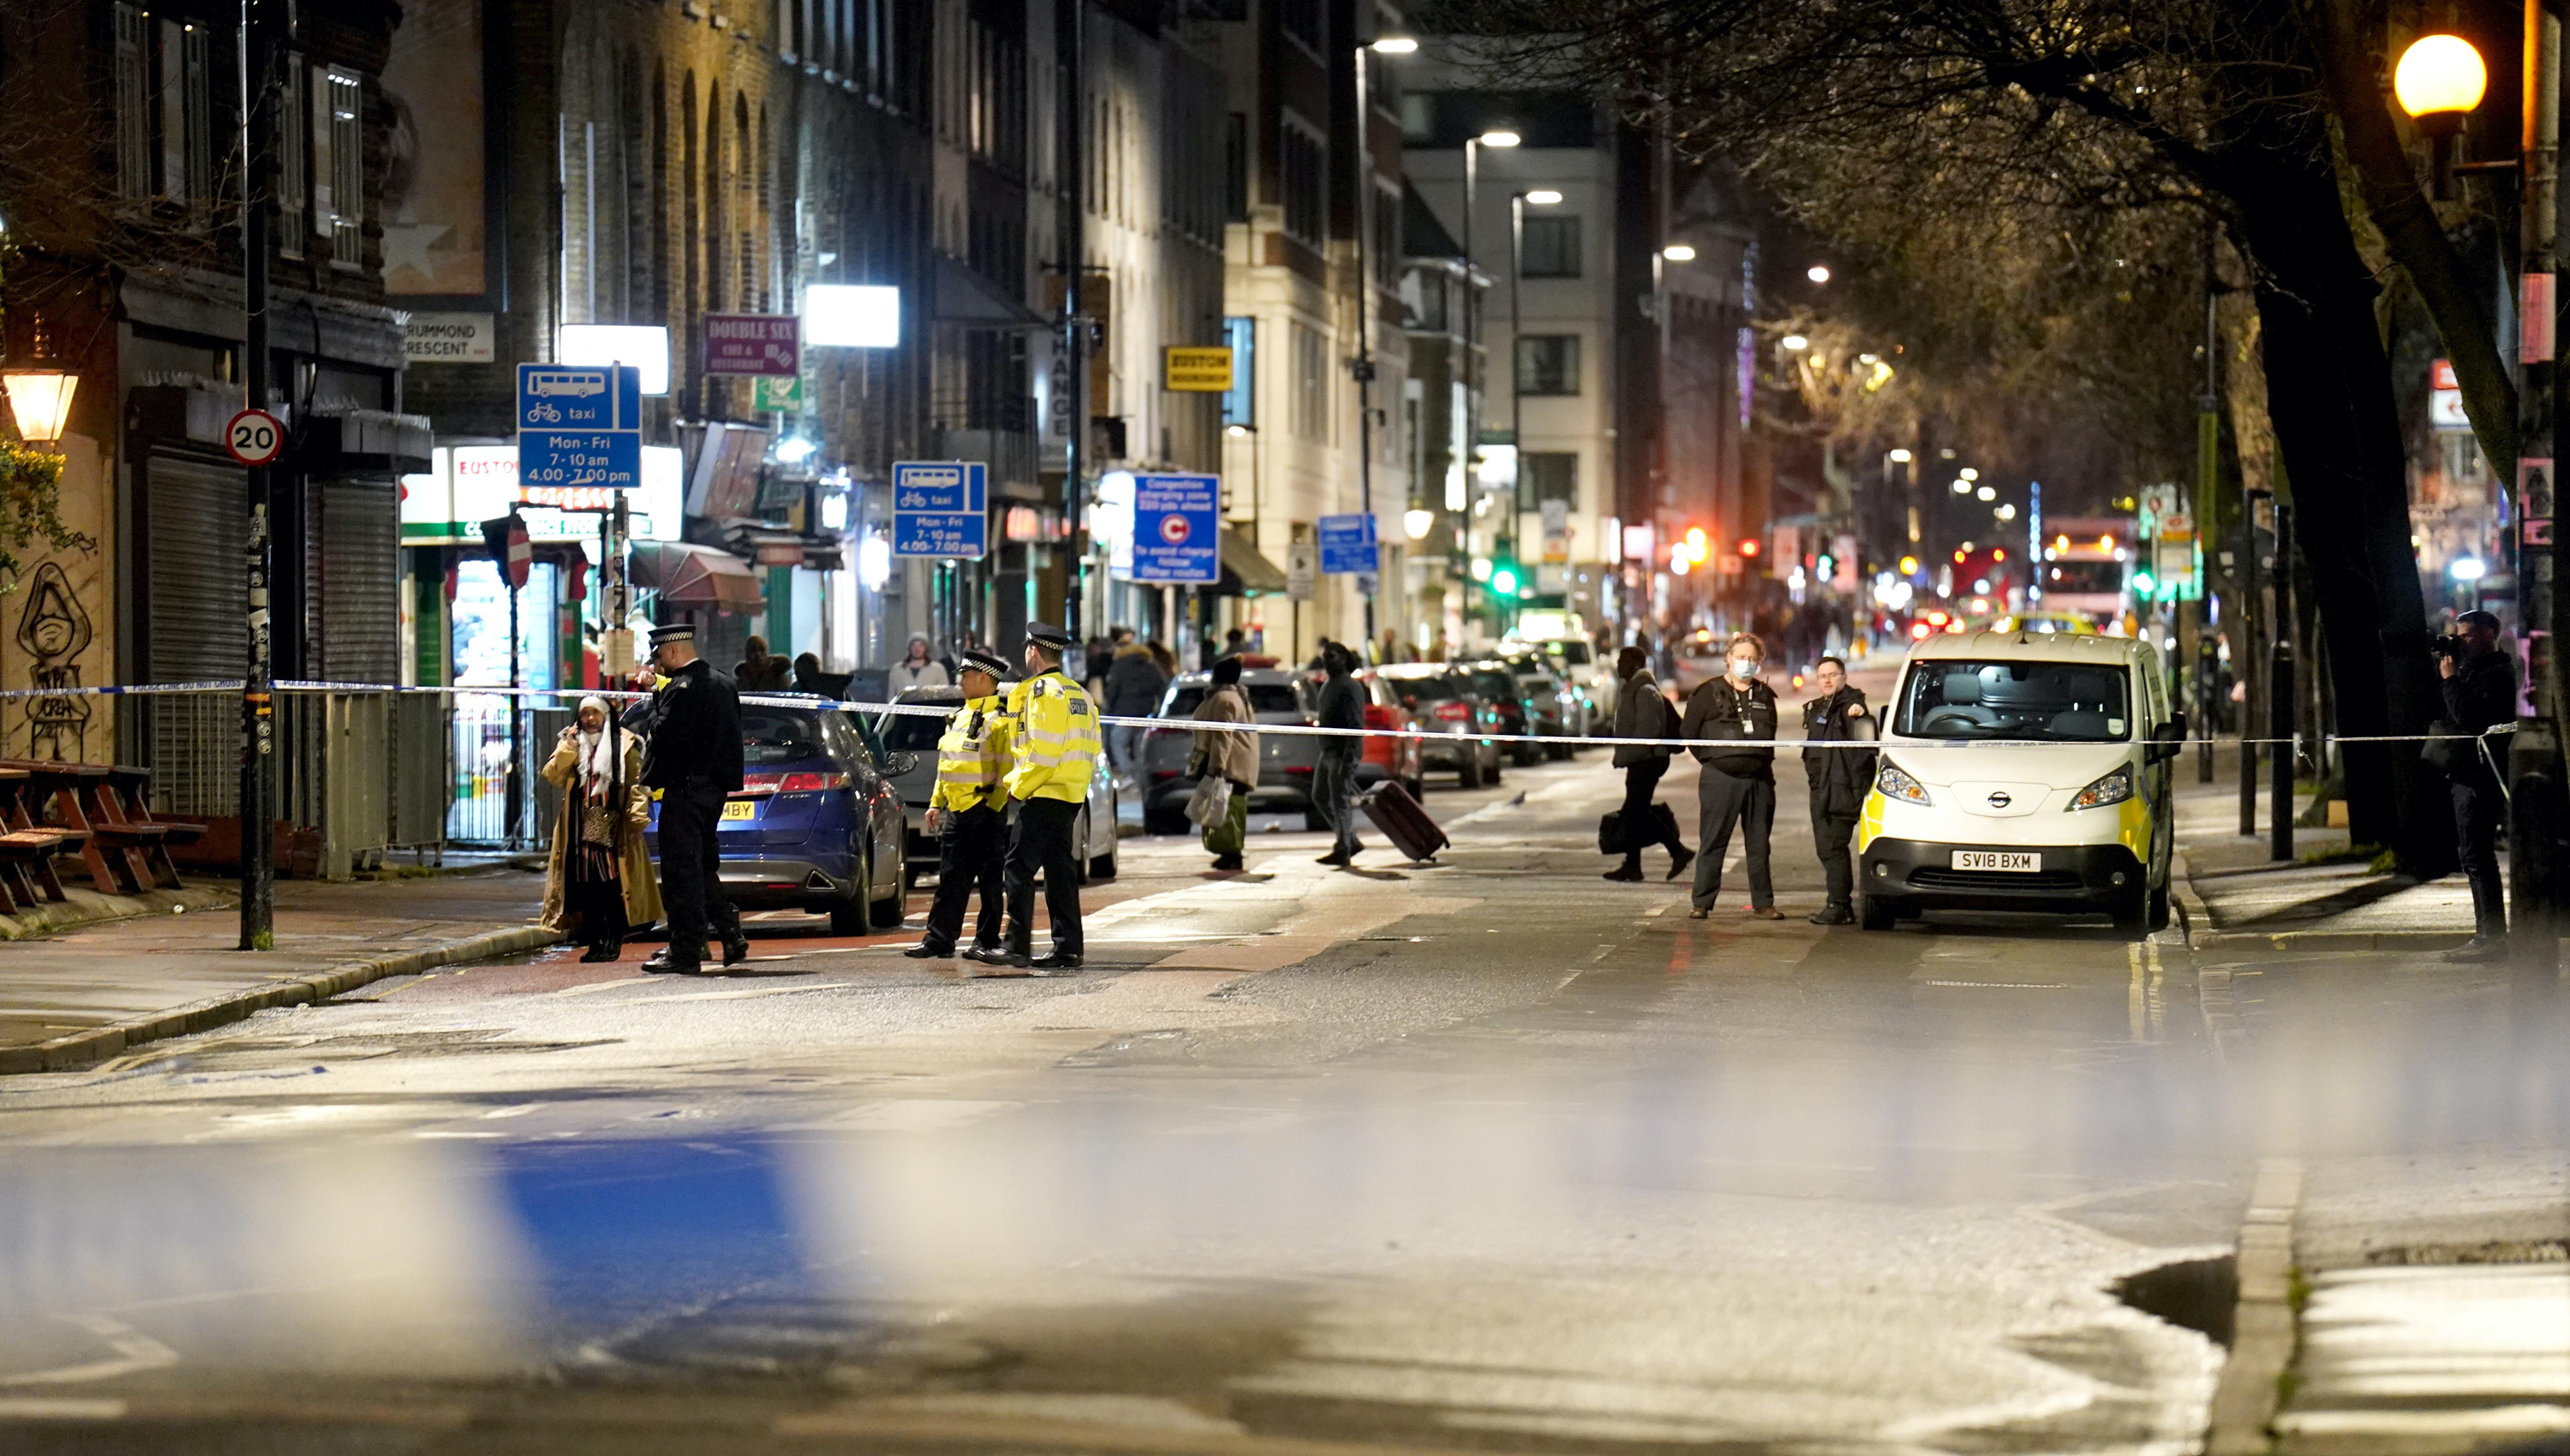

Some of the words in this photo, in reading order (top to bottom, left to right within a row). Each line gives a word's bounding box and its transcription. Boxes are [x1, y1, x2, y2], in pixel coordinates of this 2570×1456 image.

[407, 324, 475, 338] RUMMOND
[709, 320, 767, 339] DOUBLE
[770, 322, 794, 340] SIX
[406, 341, 469, 355] RESCENT
[569, 407, 595, 420] taxi
[236, 426, 273, 450] 20
[549, 436, 581, 449] Mon
[592, 437, 611, 449] Fri
[460, 461, 518, 474] EUSTO
[589, 456, 609, 466] am
[609, 471, 631, 483] pm
[931, 495, 953, 504] taxi
[916, 516, 941, 527] Mon
[948, 516, 964, 527] Fri
[134, 683, 162, 692] POLICE
[163, 683, 180, 691] LINE
[1963, 853, 1996, 867] SV18
[2001, 854, 2031, 868] BXM
